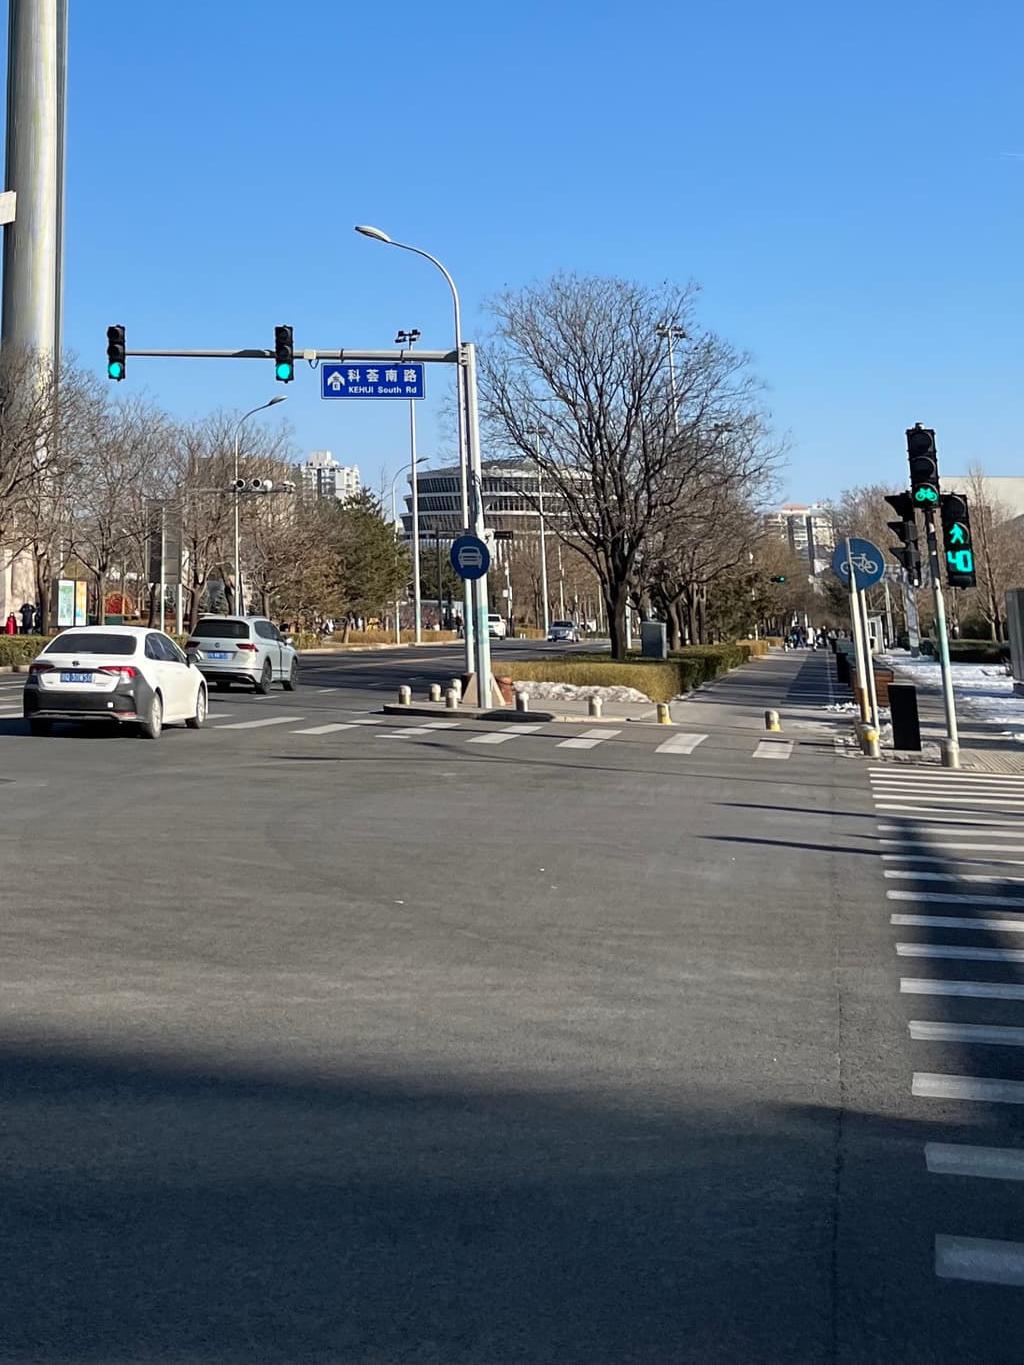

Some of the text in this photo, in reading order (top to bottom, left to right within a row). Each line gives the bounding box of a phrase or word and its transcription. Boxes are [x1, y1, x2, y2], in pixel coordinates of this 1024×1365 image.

[348, 386, 417, 394] KEHUI South Rd
[947, 550, 973, 572] 40
